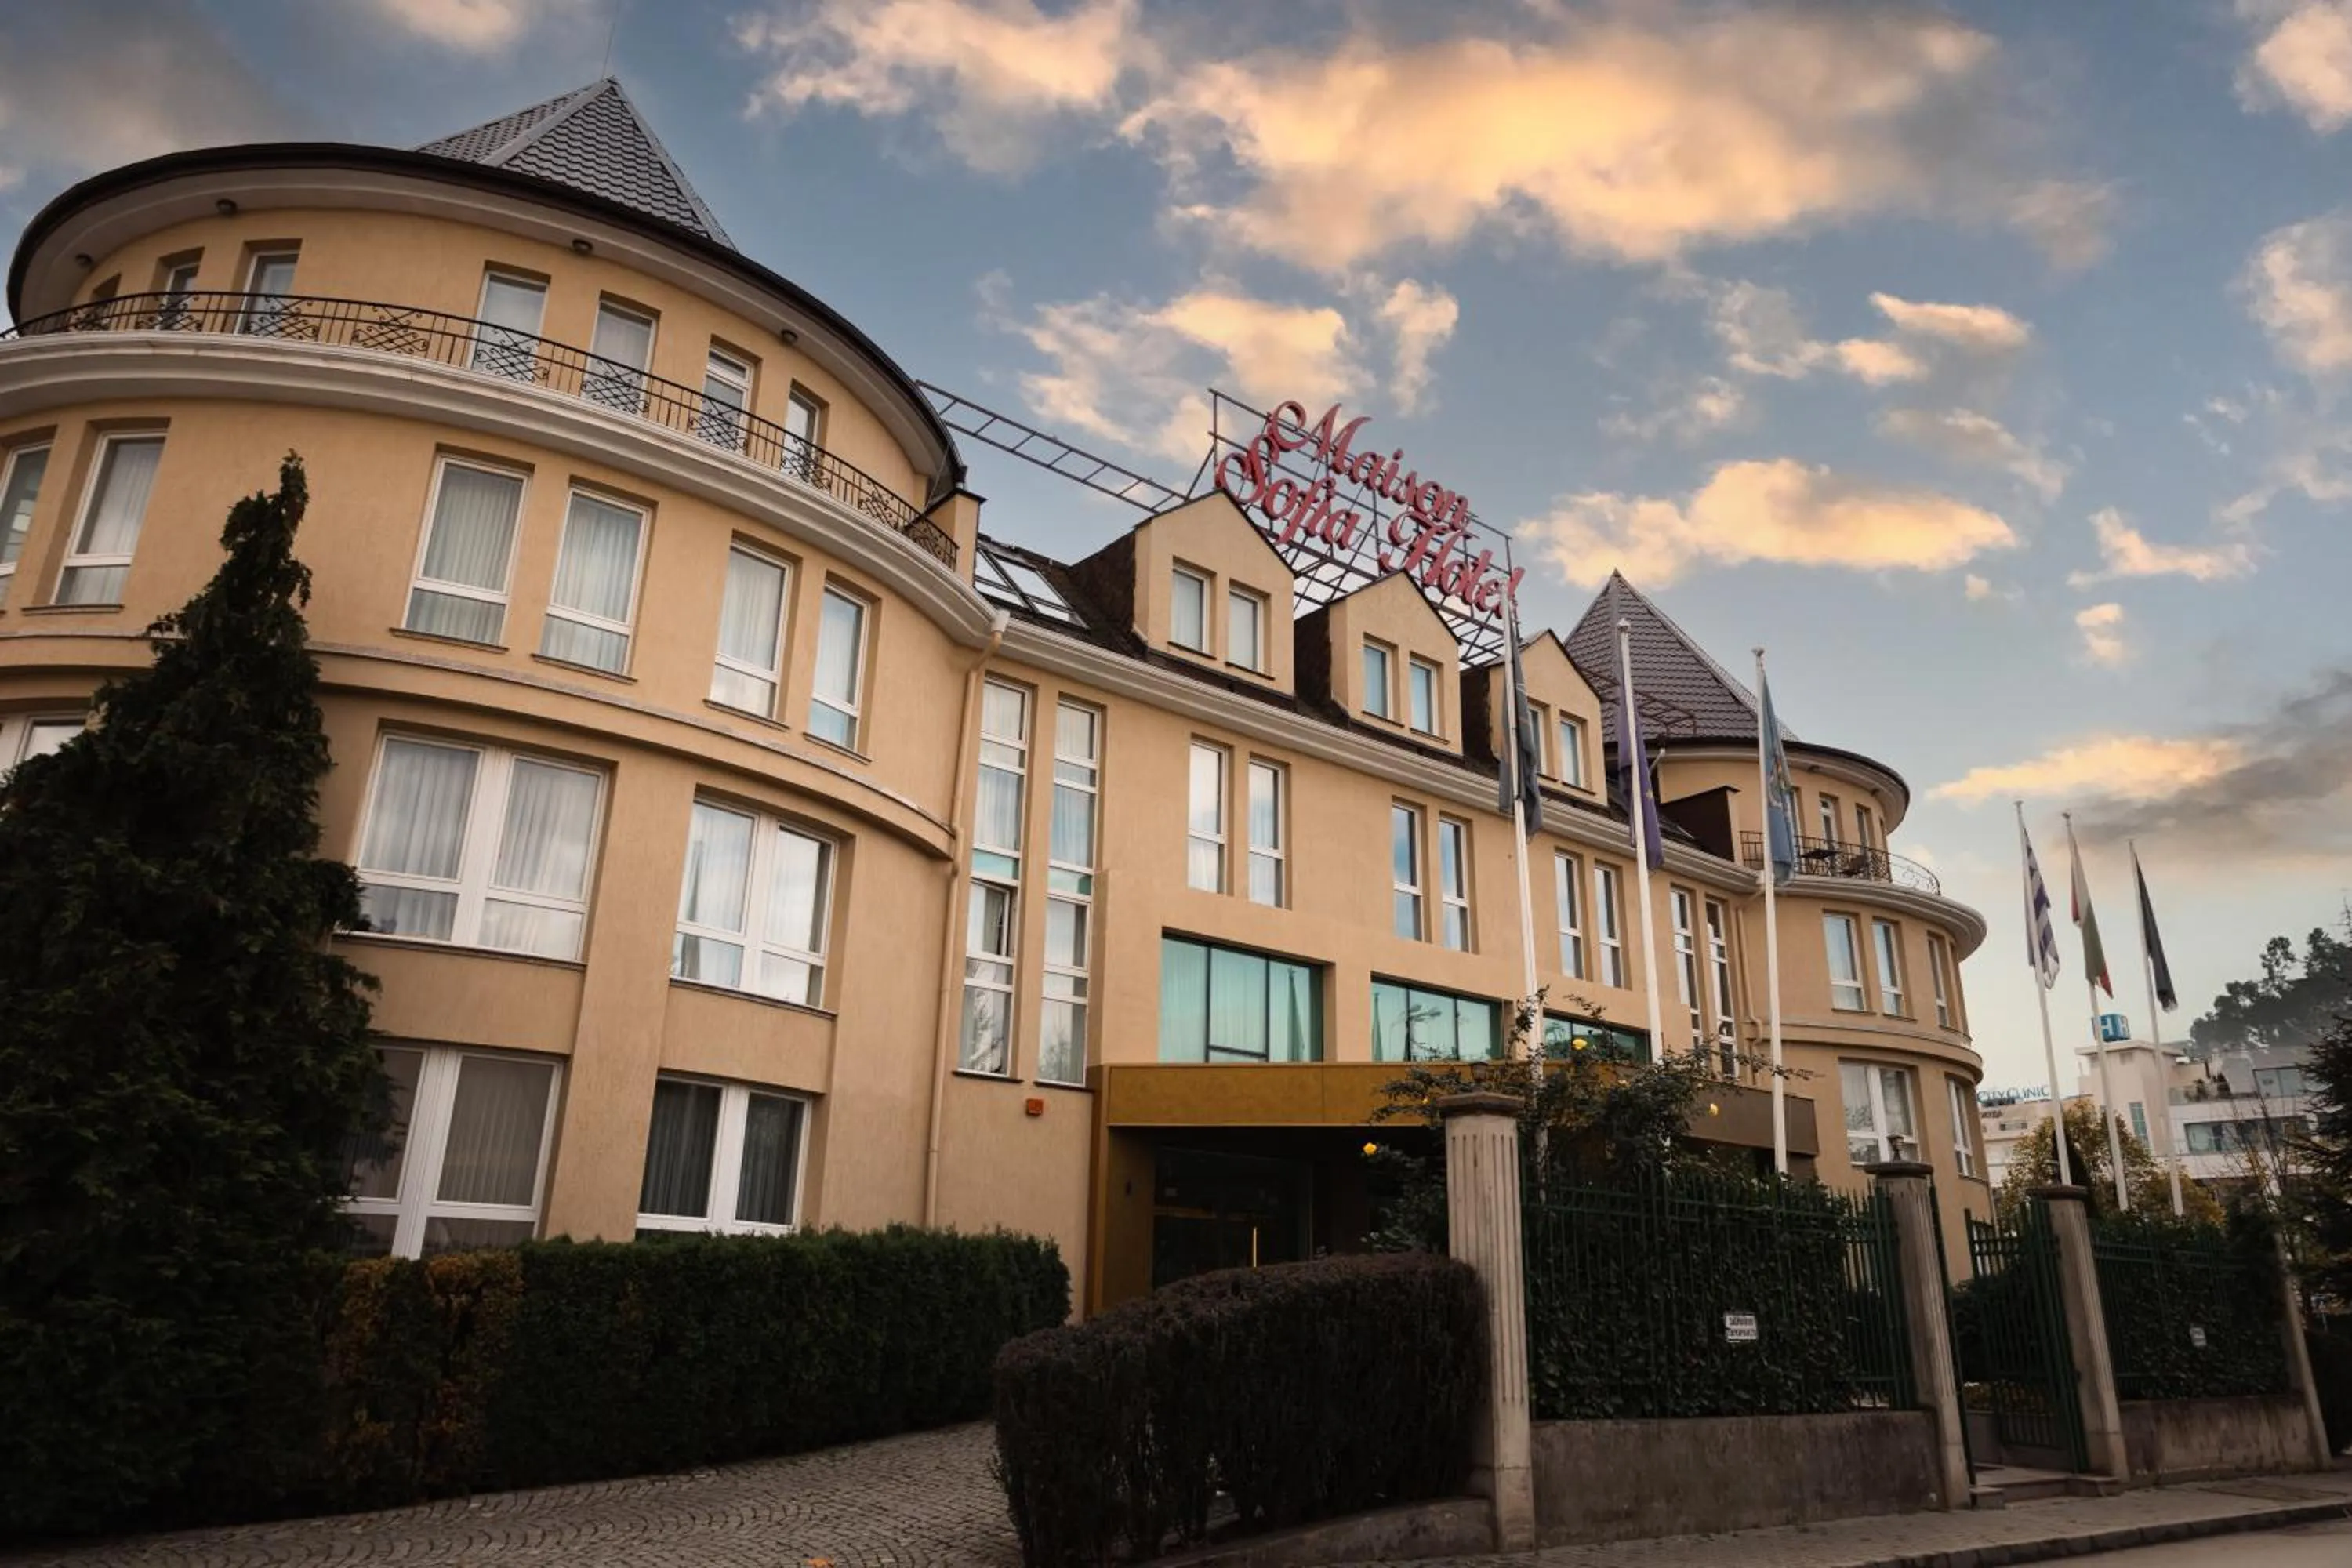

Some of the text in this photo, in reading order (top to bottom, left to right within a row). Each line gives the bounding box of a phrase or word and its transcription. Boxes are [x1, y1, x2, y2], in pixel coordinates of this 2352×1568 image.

[1215, 434, 1526, 619] Sofia Hotel
[1266, 401, 1470, 532] Maison
